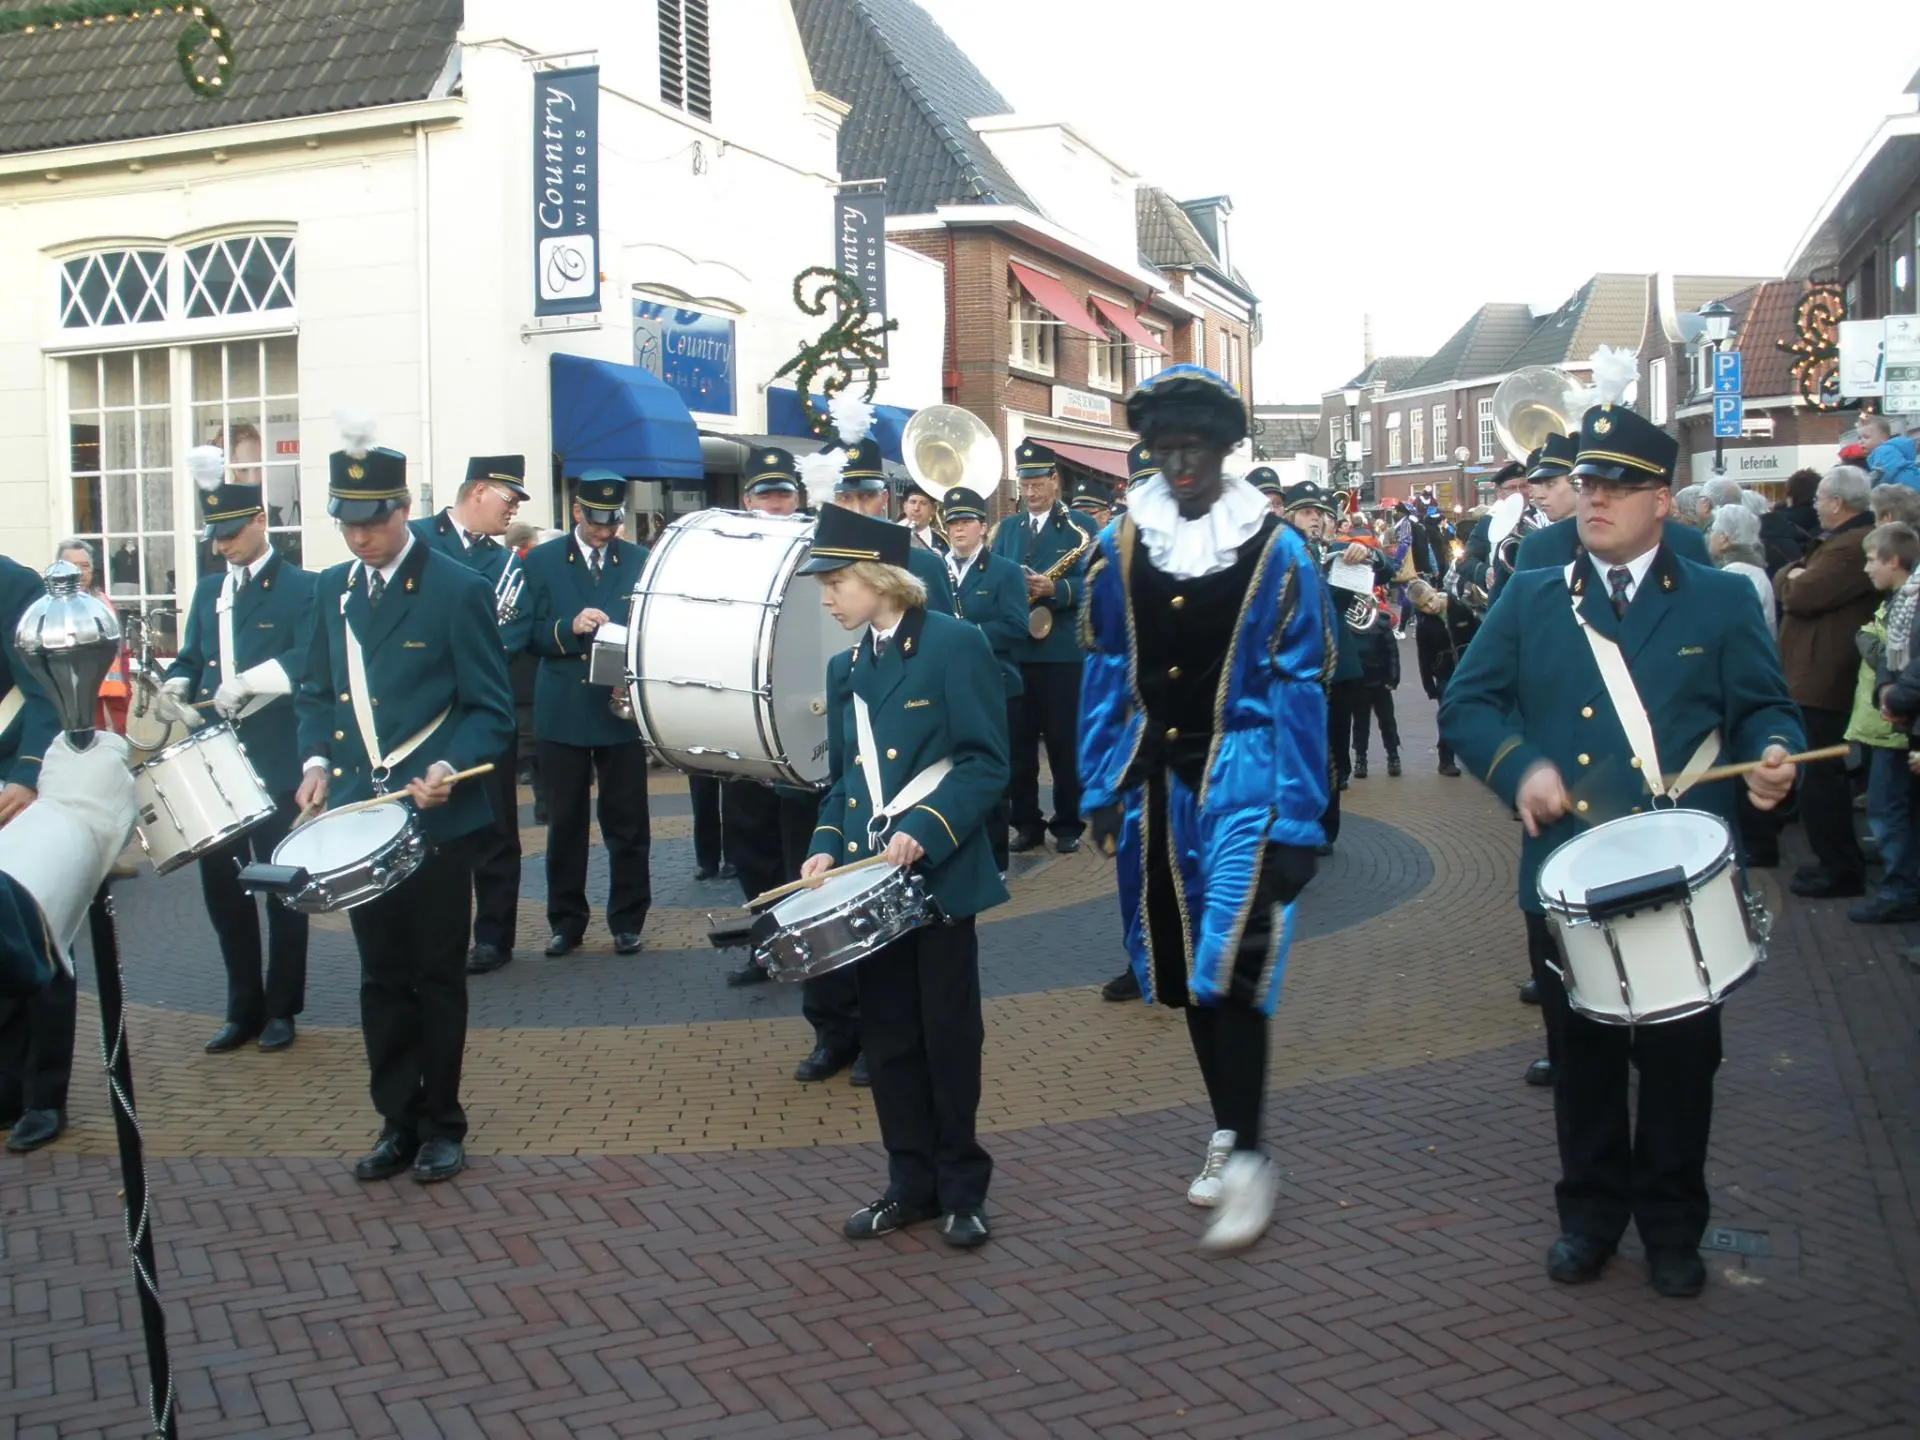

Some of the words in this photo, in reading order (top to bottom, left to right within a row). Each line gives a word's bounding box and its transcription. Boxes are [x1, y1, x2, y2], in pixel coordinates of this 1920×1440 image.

[538, 86, 576, 230] Country
[572, 128, 587, 227] wishes
[842, 205, 868, 278] untry
[865, 236, 877, 308] wishes
[666, 327, 731, 379] Country
[1719, 355, 1735, 377] P
[1720, 399, 1736, 419] P
